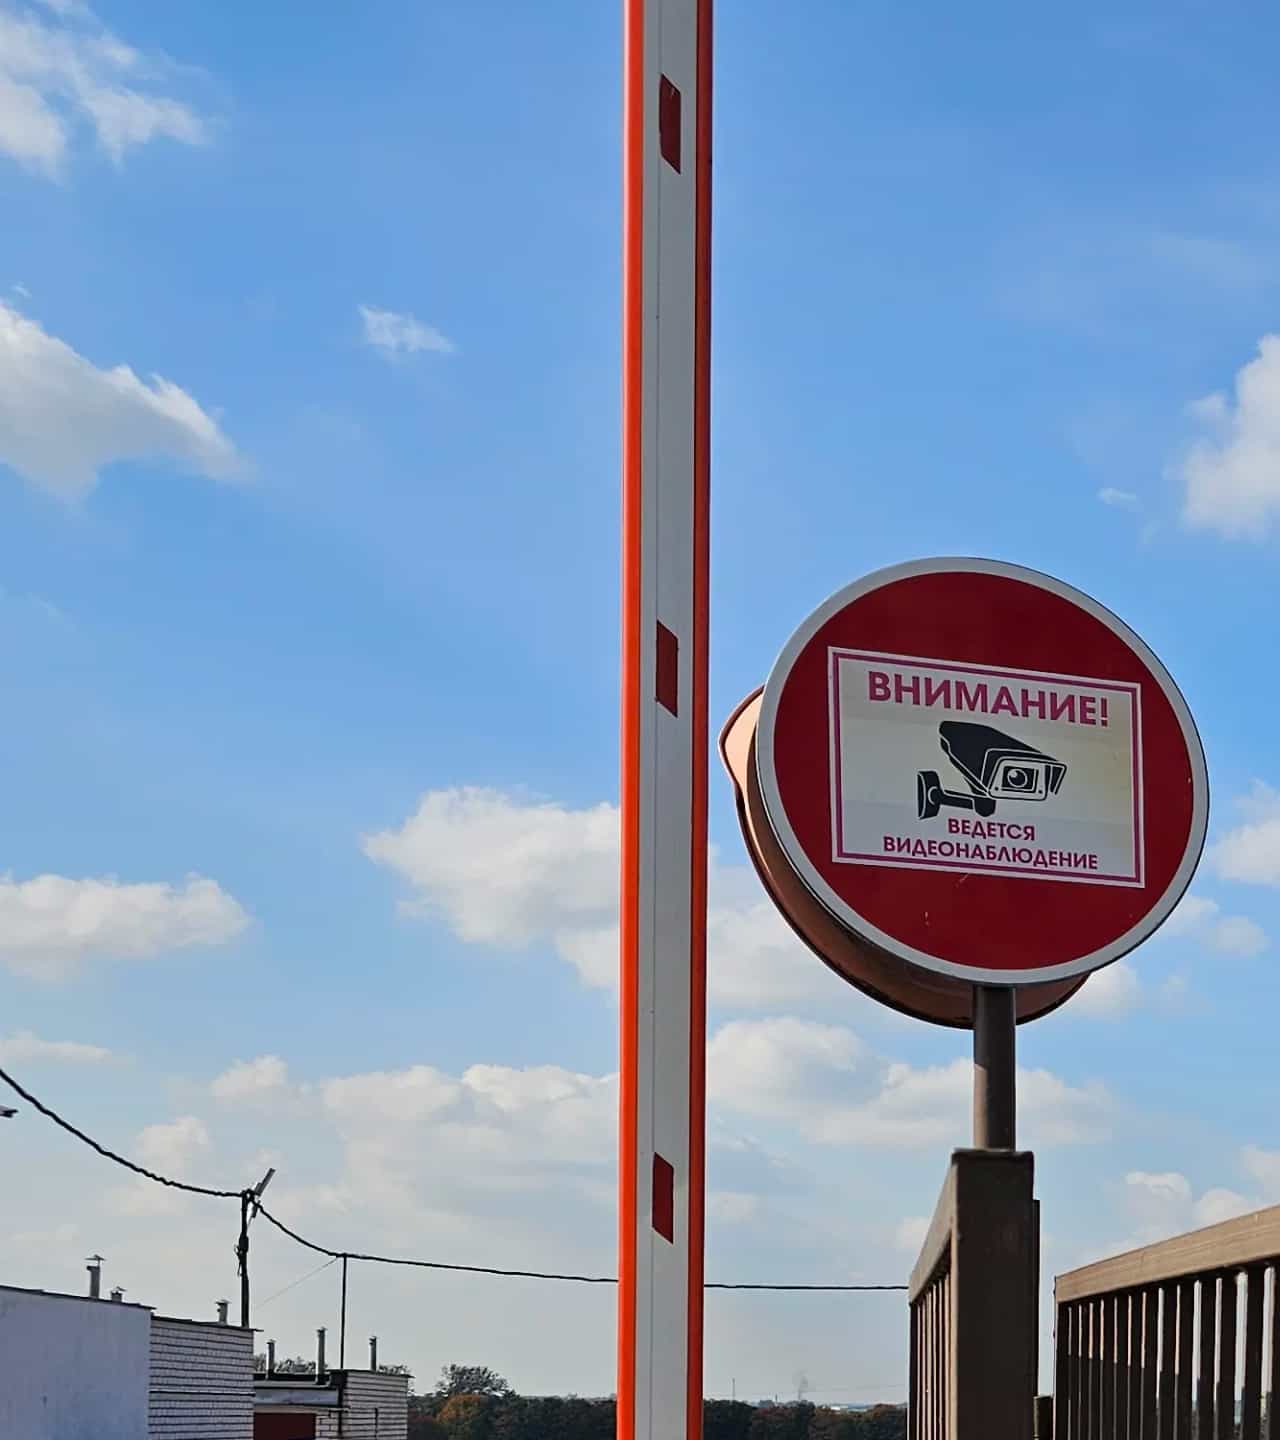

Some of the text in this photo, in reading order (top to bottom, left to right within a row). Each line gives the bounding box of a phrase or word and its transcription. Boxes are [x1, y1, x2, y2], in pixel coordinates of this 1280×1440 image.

[867, 670, 1109, 727] ВНИМАНИЕ!
[947, 818, 1036, 842] ВЕДЕТСЯ
[882, 836, 1099, 870] ВИДЕОНАБЛЮДЕНИЕ
